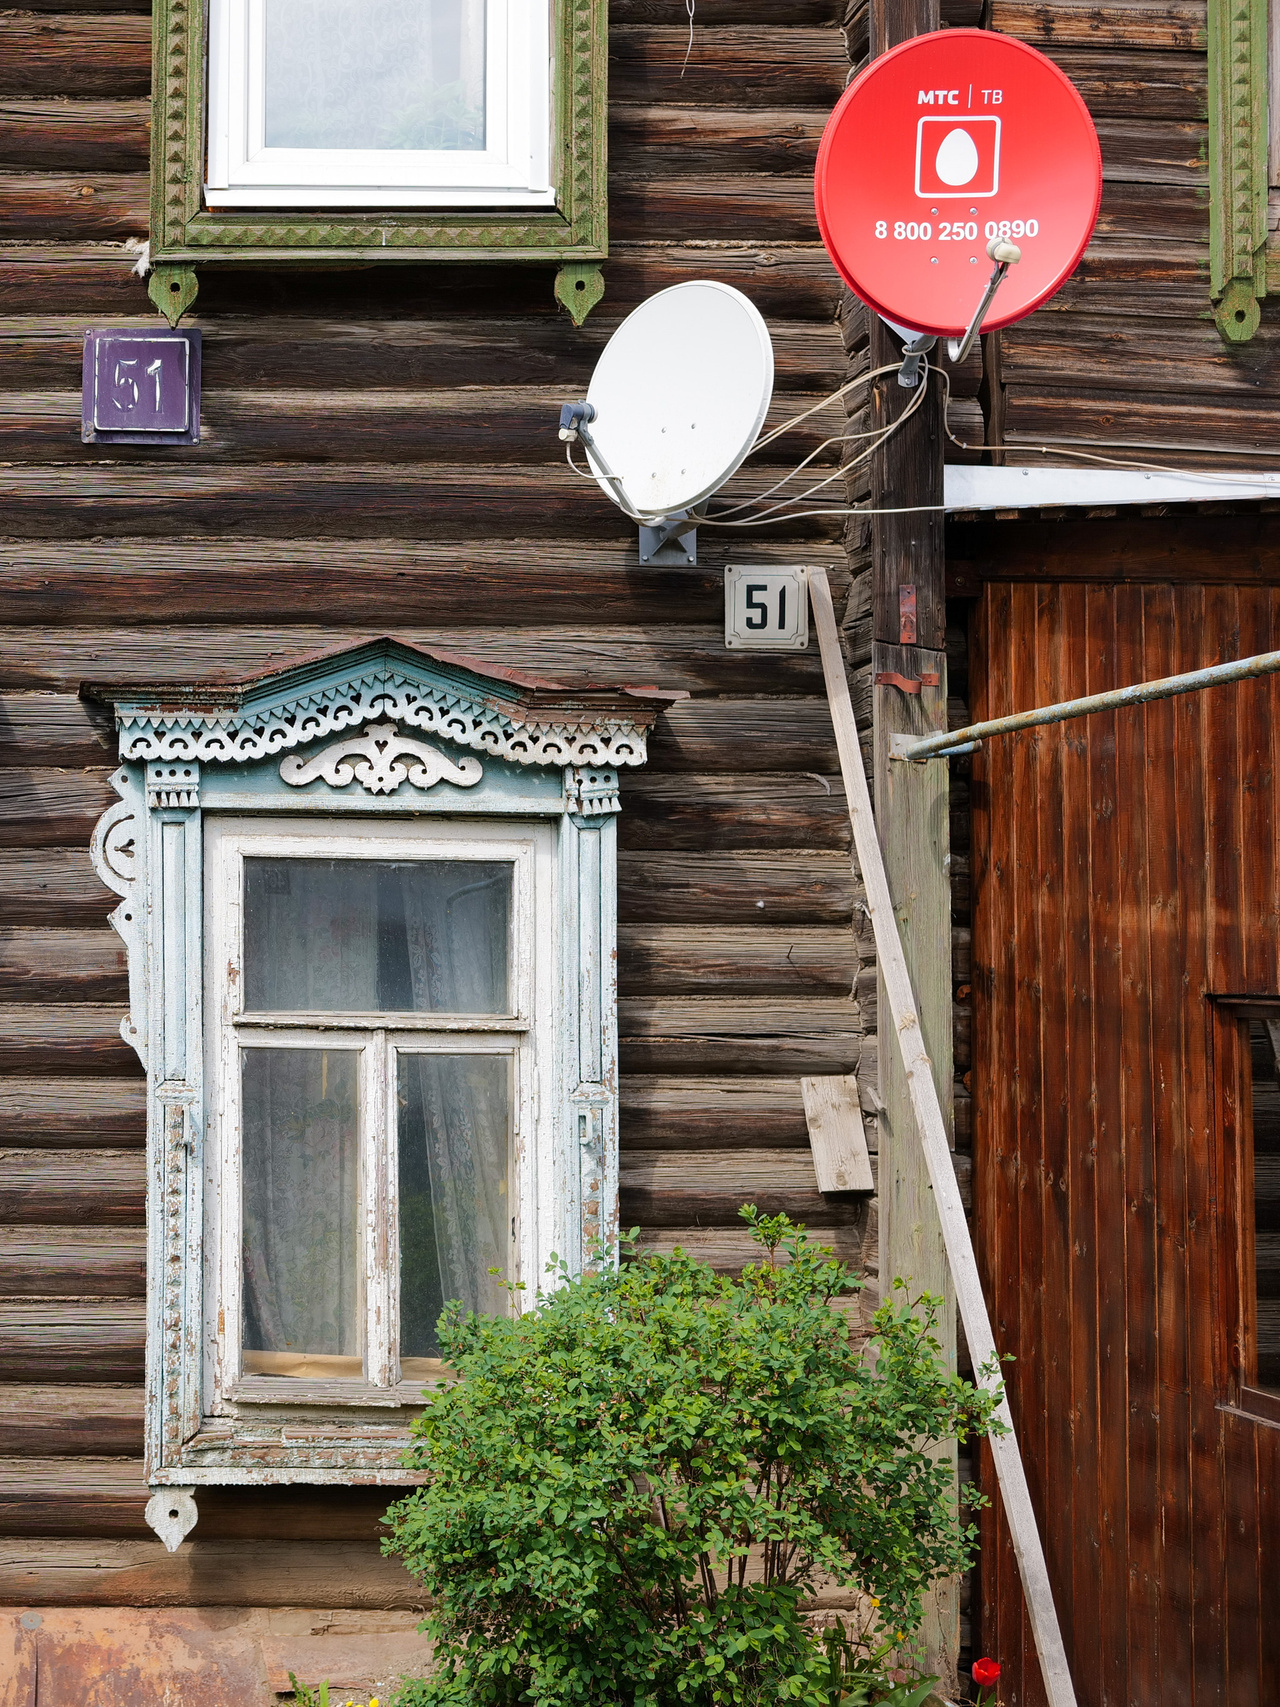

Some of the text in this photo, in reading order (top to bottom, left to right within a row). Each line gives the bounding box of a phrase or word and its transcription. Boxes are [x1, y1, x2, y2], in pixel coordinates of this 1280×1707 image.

[917, 89, 1003, 105] МТС ТВ
[874, 218, 1039, 241] 8 800 250 0890
[111, 358, 163, 414] 51
[745, 584, 786, 630] 51
